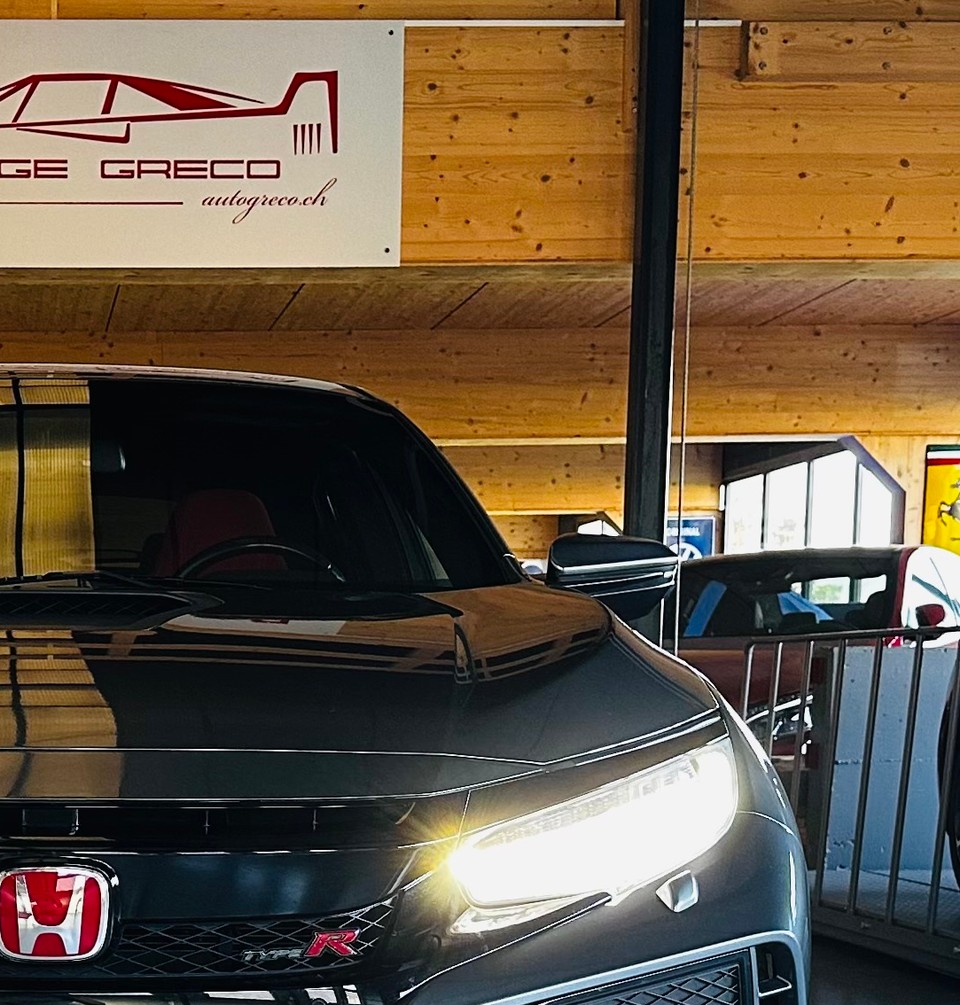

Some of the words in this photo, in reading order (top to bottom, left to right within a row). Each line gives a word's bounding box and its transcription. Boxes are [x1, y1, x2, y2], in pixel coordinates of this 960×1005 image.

[100, 159, 281, 180] GRECO
[201, 178, 337, 224] autogreco.ch
[241, 947, 304, 963] TYPE
[303, 929, 361, 957] R
